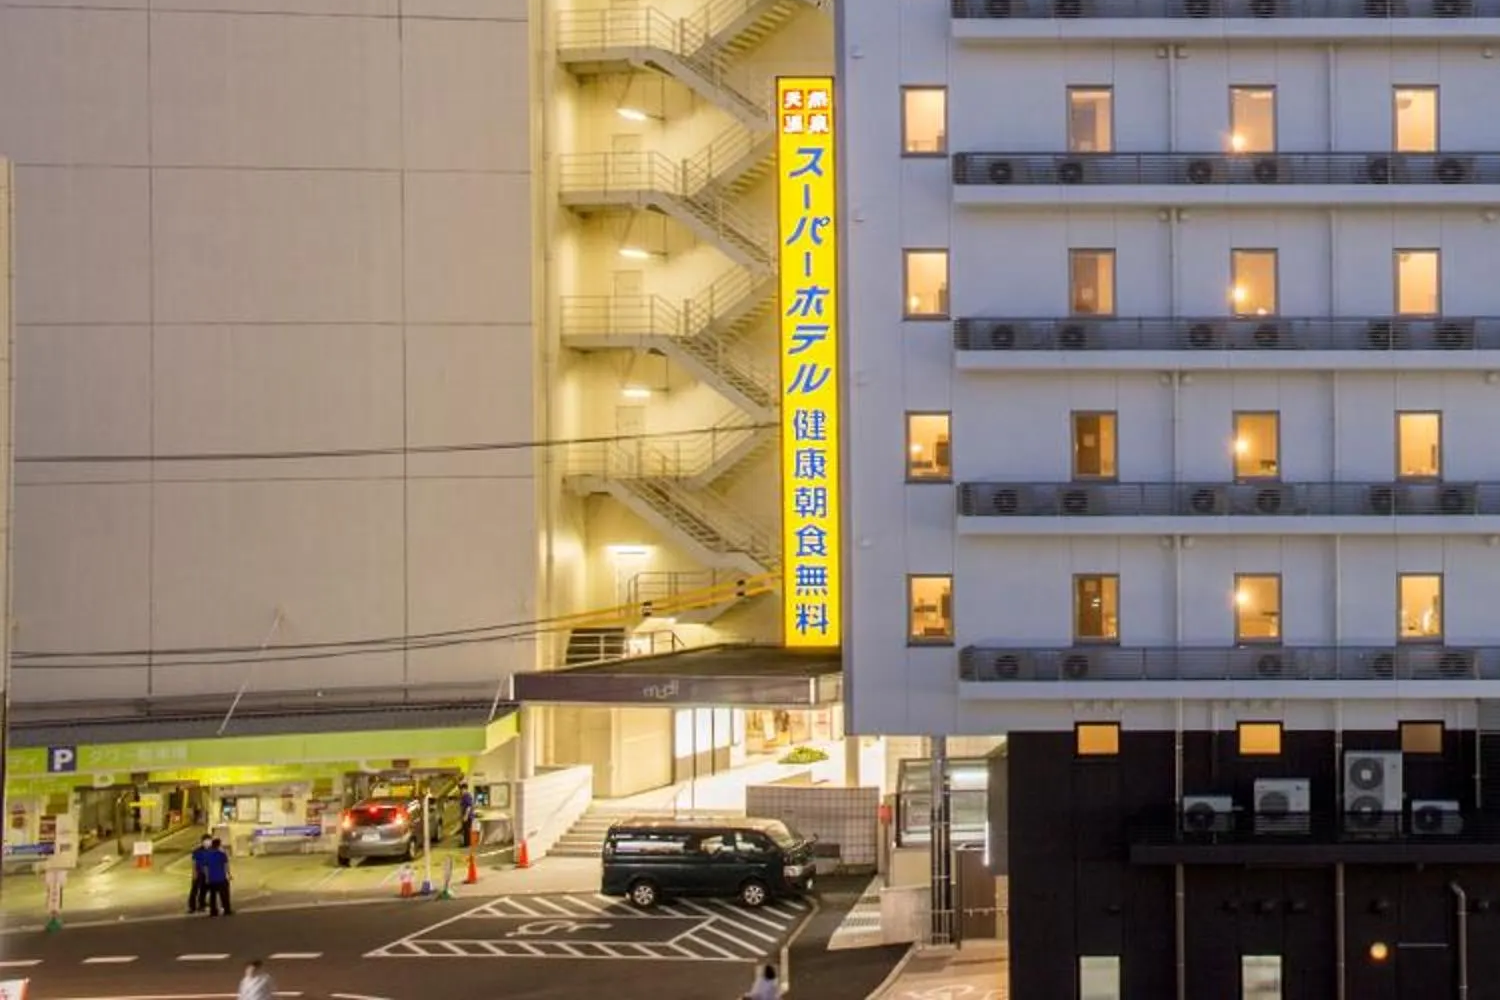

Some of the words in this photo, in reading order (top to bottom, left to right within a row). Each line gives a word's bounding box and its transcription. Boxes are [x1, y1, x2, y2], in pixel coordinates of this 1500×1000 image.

[786, 147, 831, 394] スーパーホテル
[793, 409, 829, 635] 健康朝食無料
[53, 749, 74, 771] P
